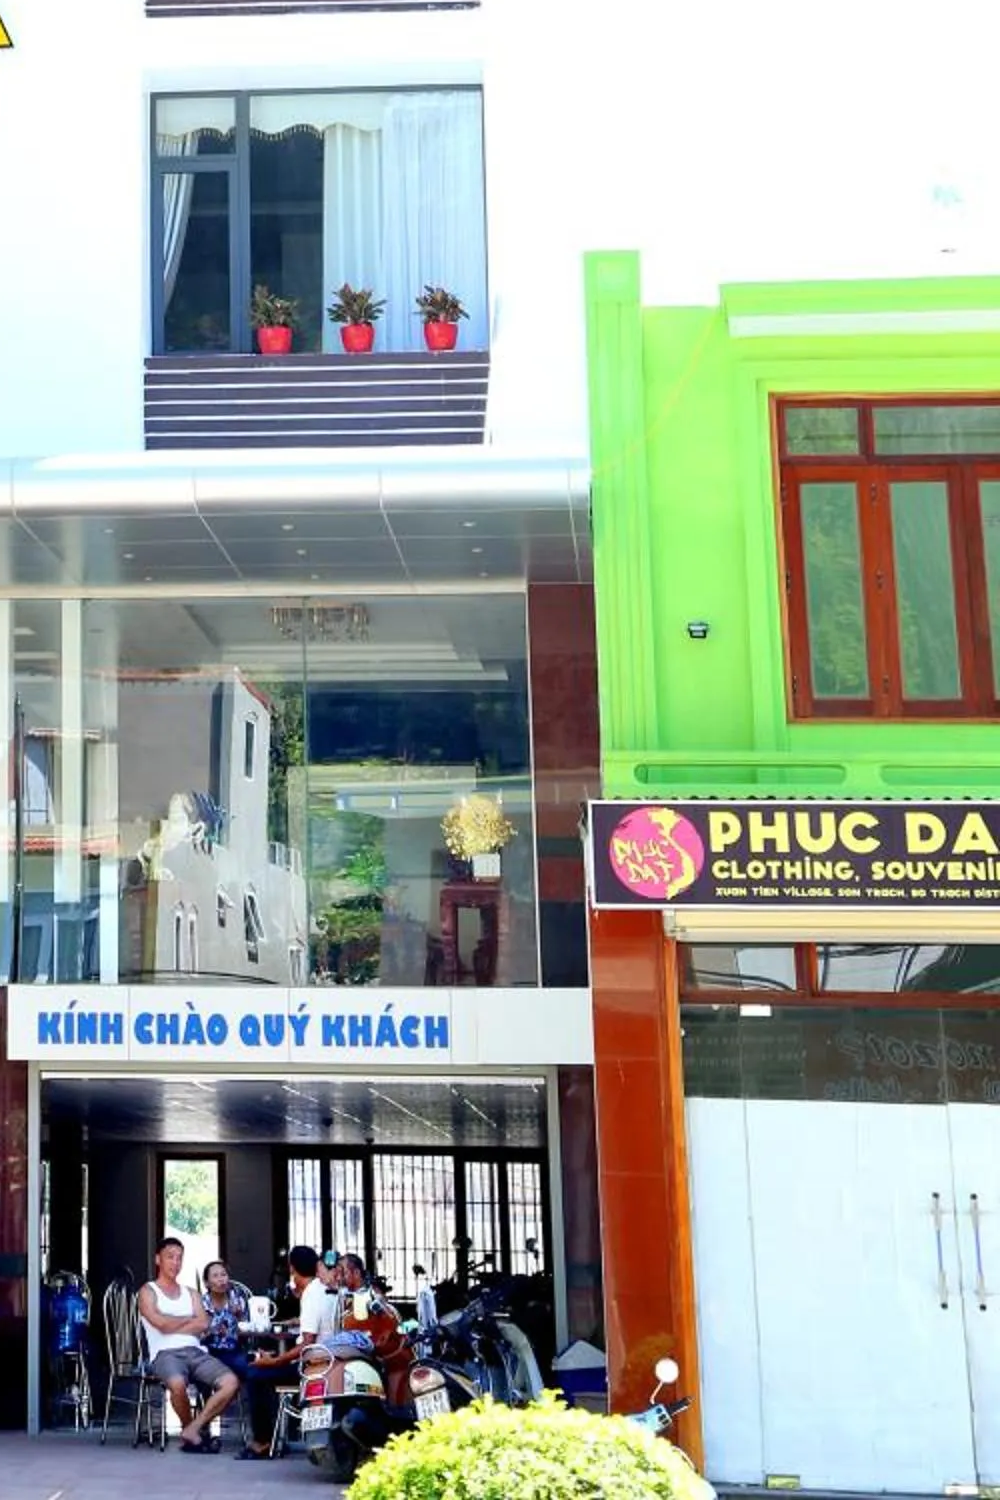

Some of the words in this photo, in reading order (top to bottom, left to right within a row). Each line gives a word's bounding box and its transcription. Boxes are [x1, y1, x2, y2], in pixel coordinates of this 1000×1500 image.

[707, 811, 881, 854] PHUC
[37, 999, 124, 1045] KÍNH
[133, 1001, 228, 1046] CHÀO
[239, 1003, 310, 1047] QUÝ
[321, 1003, 449, 1048] KHÁCH
